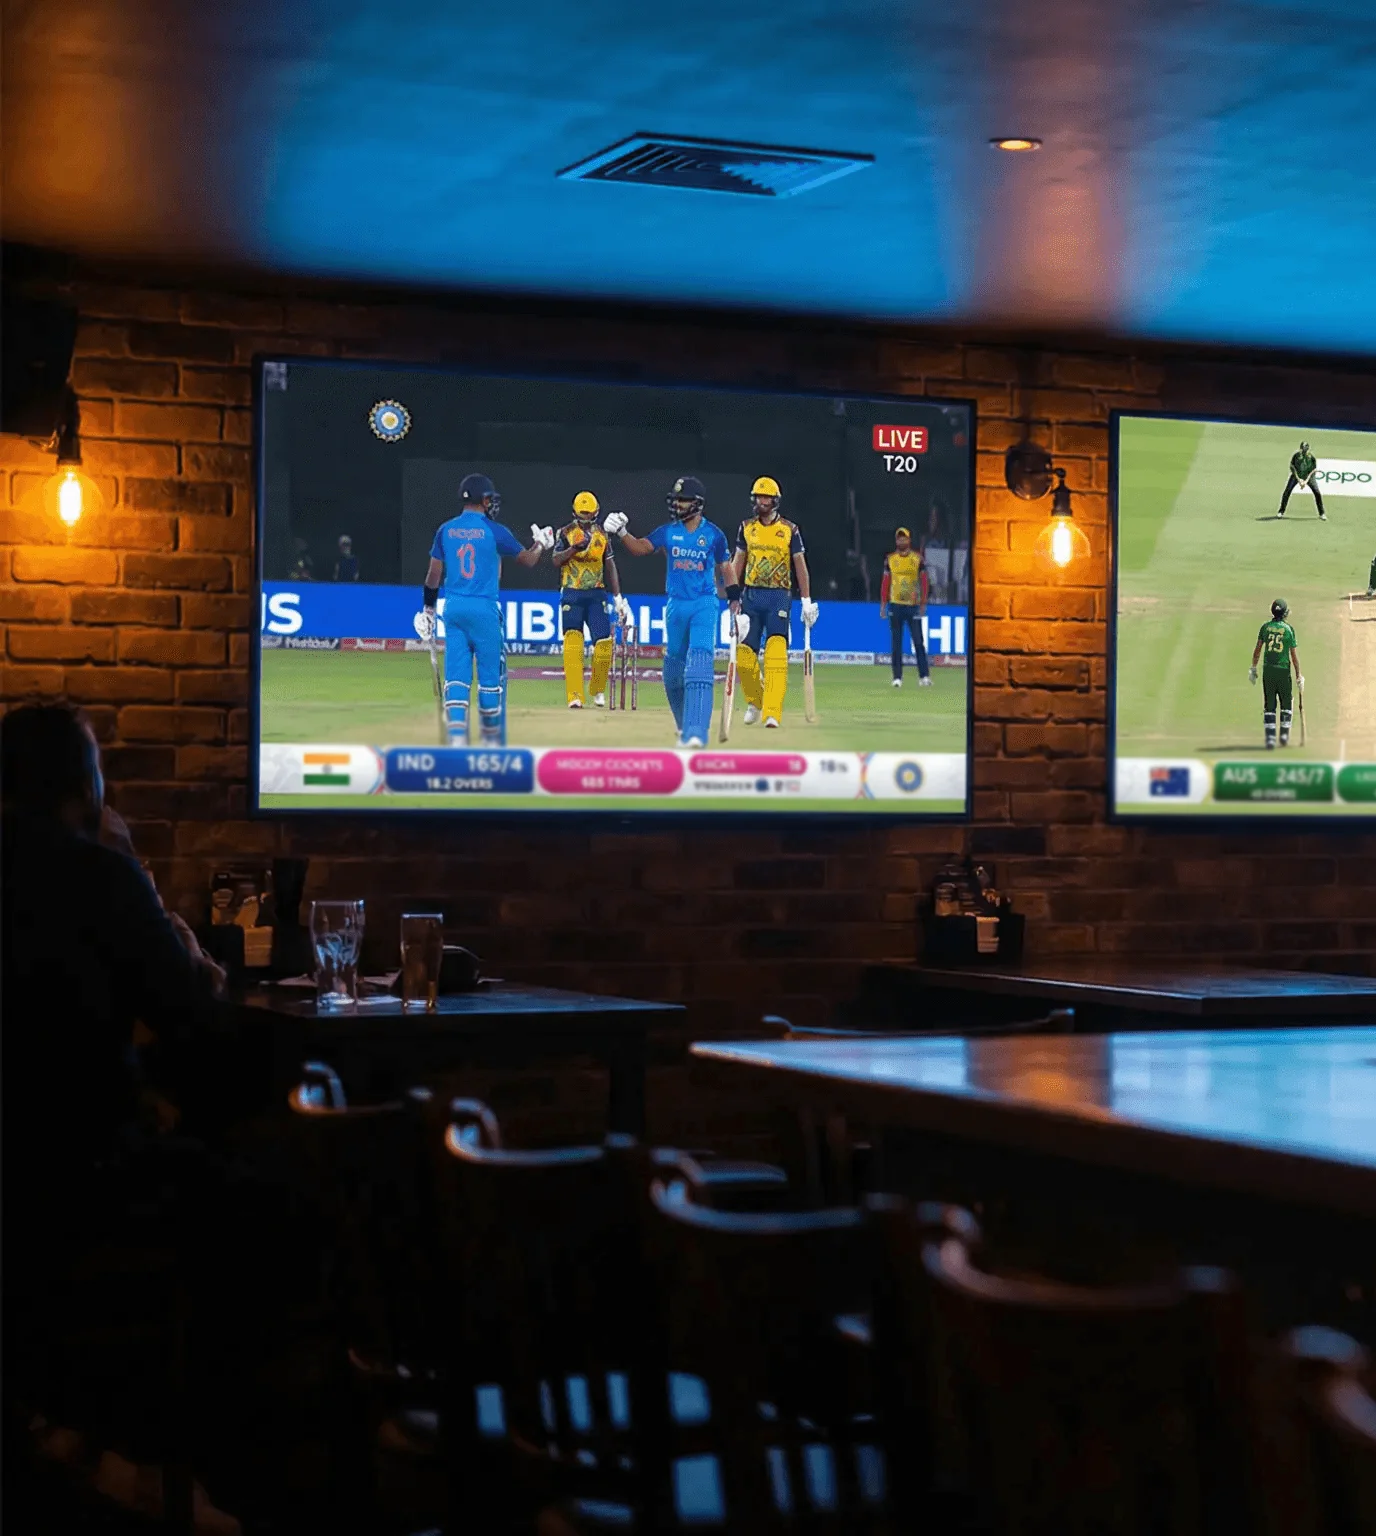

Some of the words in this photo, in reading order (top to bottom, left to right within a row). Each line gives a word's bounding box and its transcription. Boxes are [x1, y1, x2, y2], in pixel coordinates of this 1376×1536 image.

[878, 428, 924, 449] LIVE
[882, 454, 918, 474] T20
[1314, 469, 1373, 484] oppo
[397, 754, 435, 771] IND
[466, 755, 523, 775] 165/4
[453, 778, 494, 790] OVERS
[1222, 767, 1258, 784] AUS
[1276, 767, 1325, 785] 245/7
